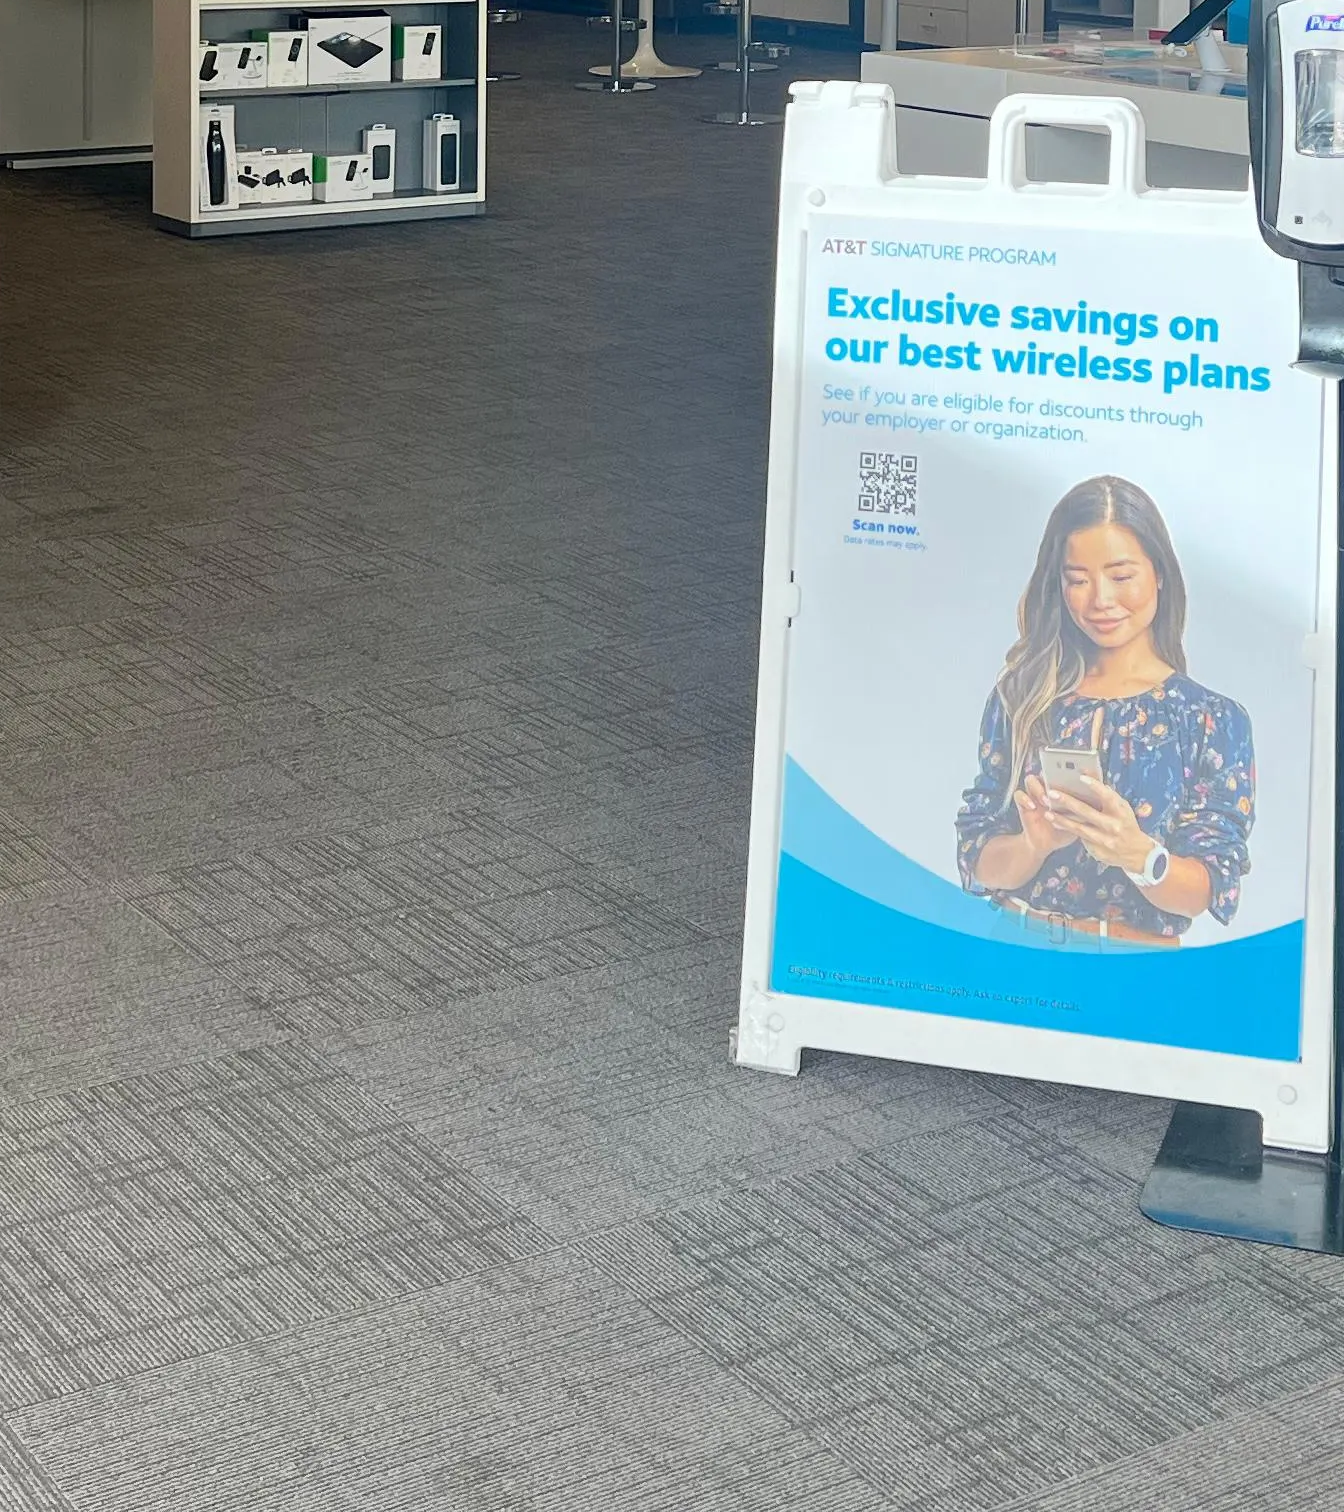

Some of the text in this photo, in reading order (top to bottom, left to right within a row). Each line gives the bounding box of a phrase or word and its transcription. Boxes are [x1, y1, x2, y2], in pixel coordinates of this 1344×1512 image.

[822, 238, 1056, 266] AT&T SIGNATURE PROGRAM
[828, 287, 1219, 346] Exclusive savings on
[825, 333, 1271, 394] our best wireless plans
[823, 384, 1203, 431] See if you are eligible for discounts through
[822, 409, 1088, 443] your employer or organization.
[843, 535, 863, 545] Data
[864, 537, 885, 546] rates
[886, 539, 903, 550] may
[852, 519, 920, 536] Scan now.
